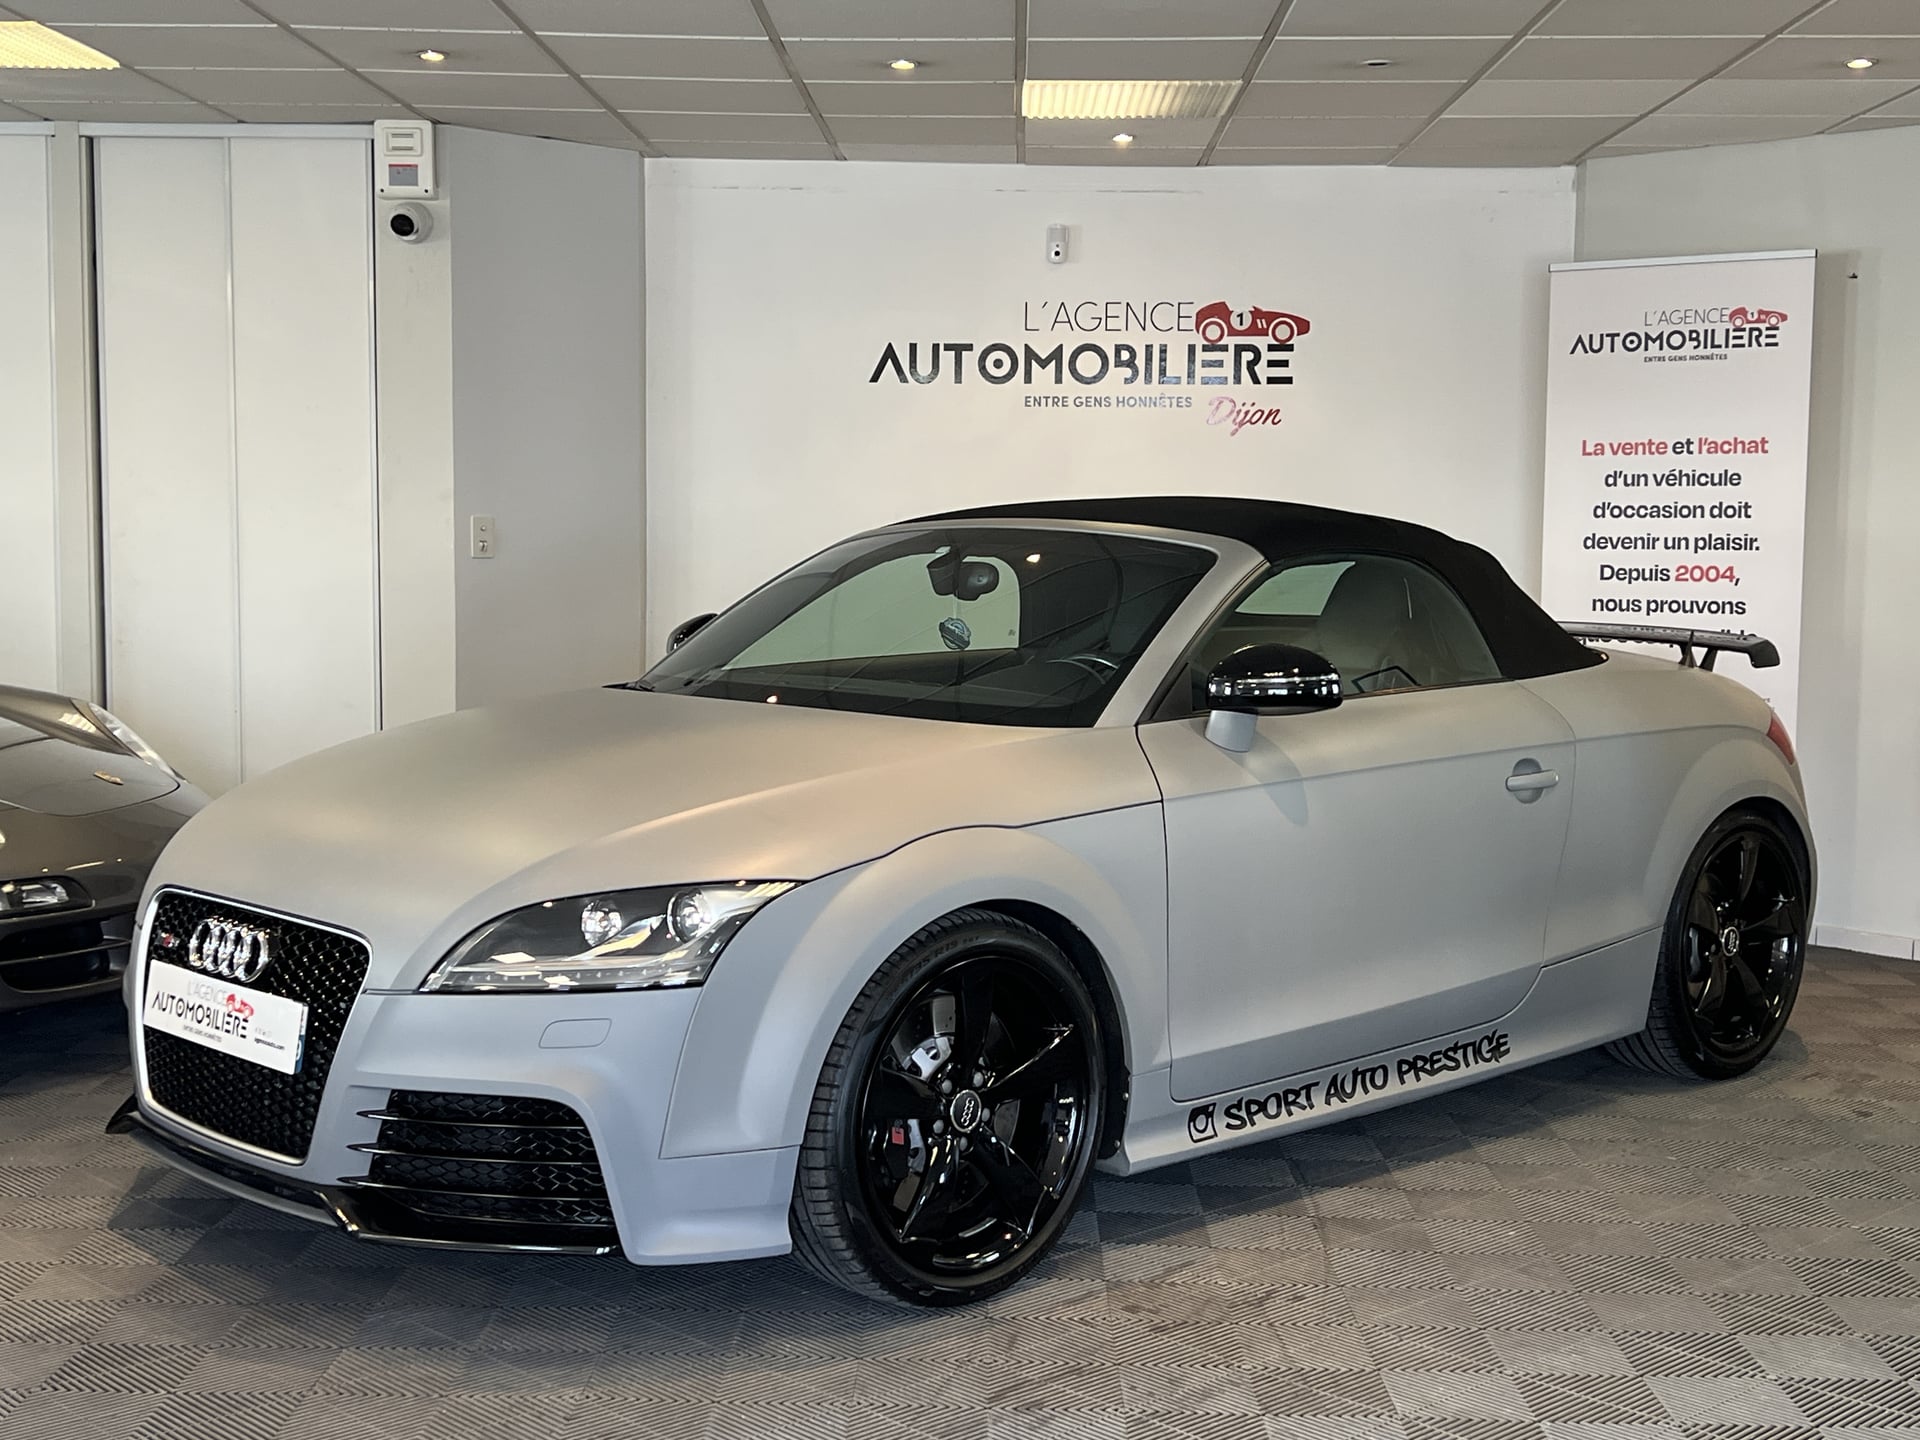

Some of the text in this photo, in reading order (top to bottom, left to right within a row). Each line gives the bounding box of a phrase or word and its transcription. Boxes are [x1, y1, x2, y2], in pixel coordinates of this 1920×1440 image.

[1024, 301, 1195, 332] L'AGENCE
[1644, 307, 1730, 326] L'AGENCE
[1643, 355, 1667, 363] ENTRE
[1668, 354, 1688, 362] GENS
[1024, 392, 1193, 408] ENTRE GENS HONNÊTES
[1206, 395, 1282, 437] Dijon
[1581, 436, 1769, 456] La vente et l'achat
[1604, 468, 1742, 487] d'un véhicule
[1592, 501, 1752, 519] d'occasion doit
[1583, 533, 1760, 554] devenir un plaisir.
[1599, 564, 1740, 587] Depuis 2004,
[1592, 597, 1747, 616] nous prouvons
[1224, 1029, 1510, 1130] SPORT AUTO PRESTIGE
